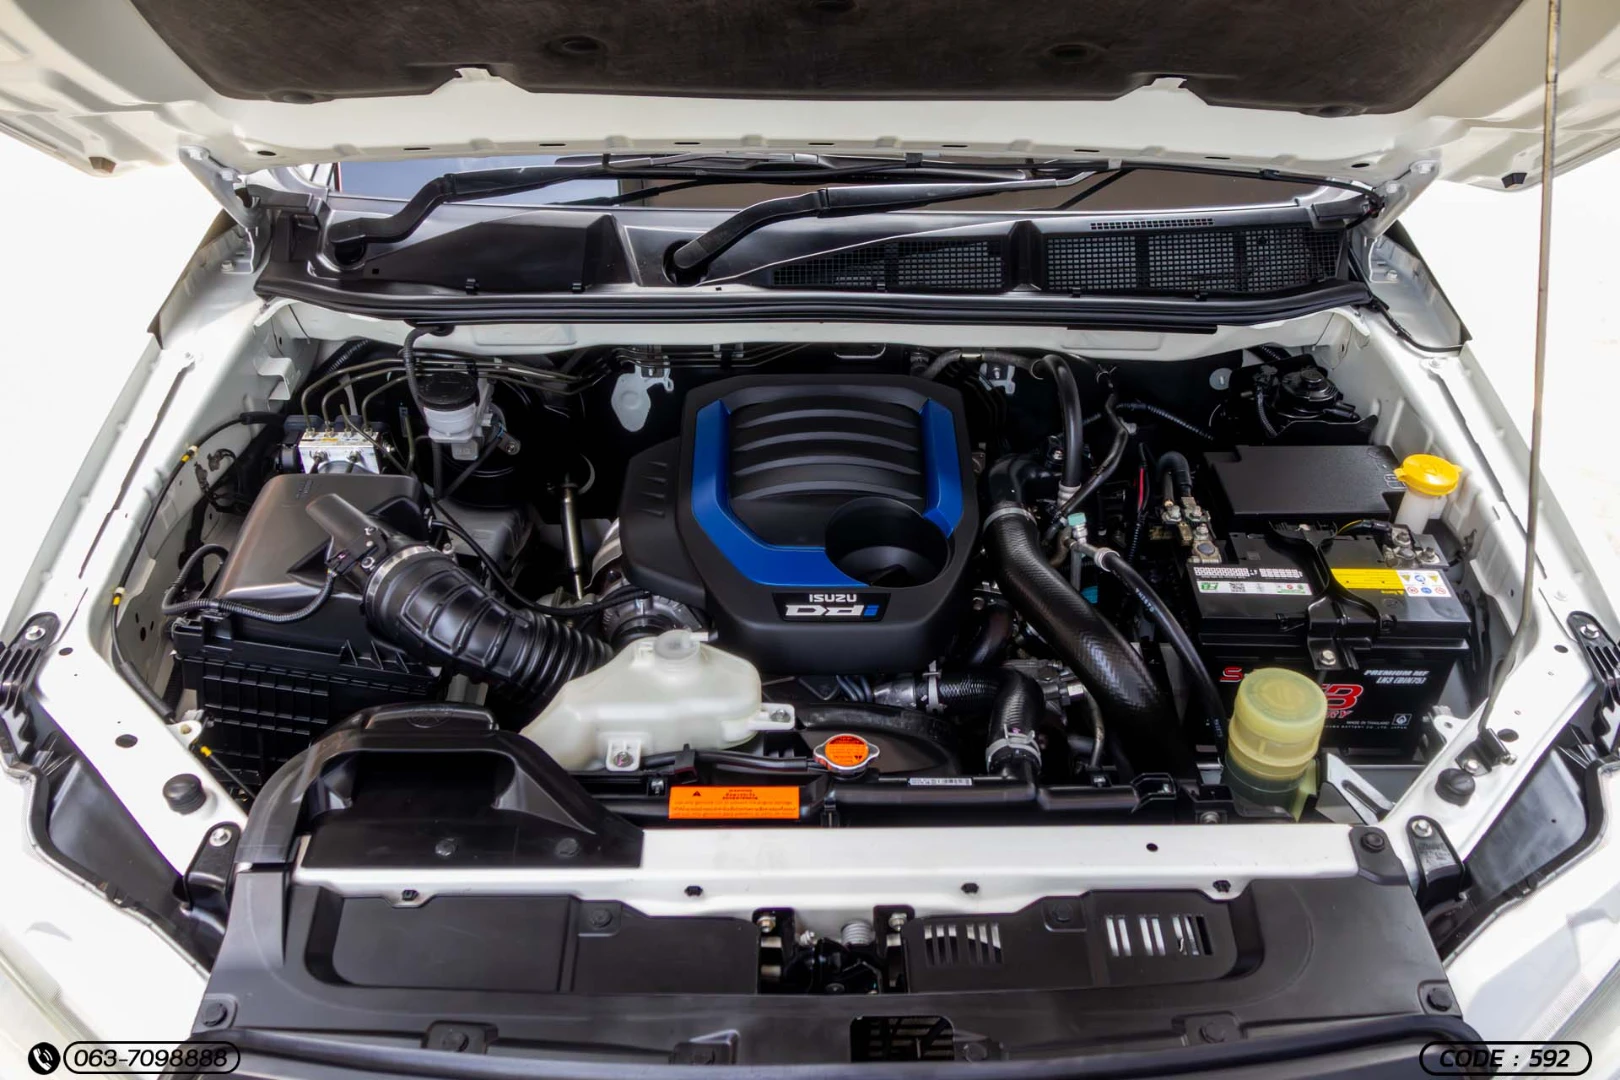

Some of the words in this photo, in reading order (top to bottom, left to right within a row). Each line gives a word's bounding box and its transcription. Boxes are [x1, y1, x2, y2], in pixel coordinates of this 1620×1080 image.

[809, 593, 858, 603] ISUZU
[1393, 676, 1427, 684] (DIN75)
[1321, 683, 1364, 710] B
